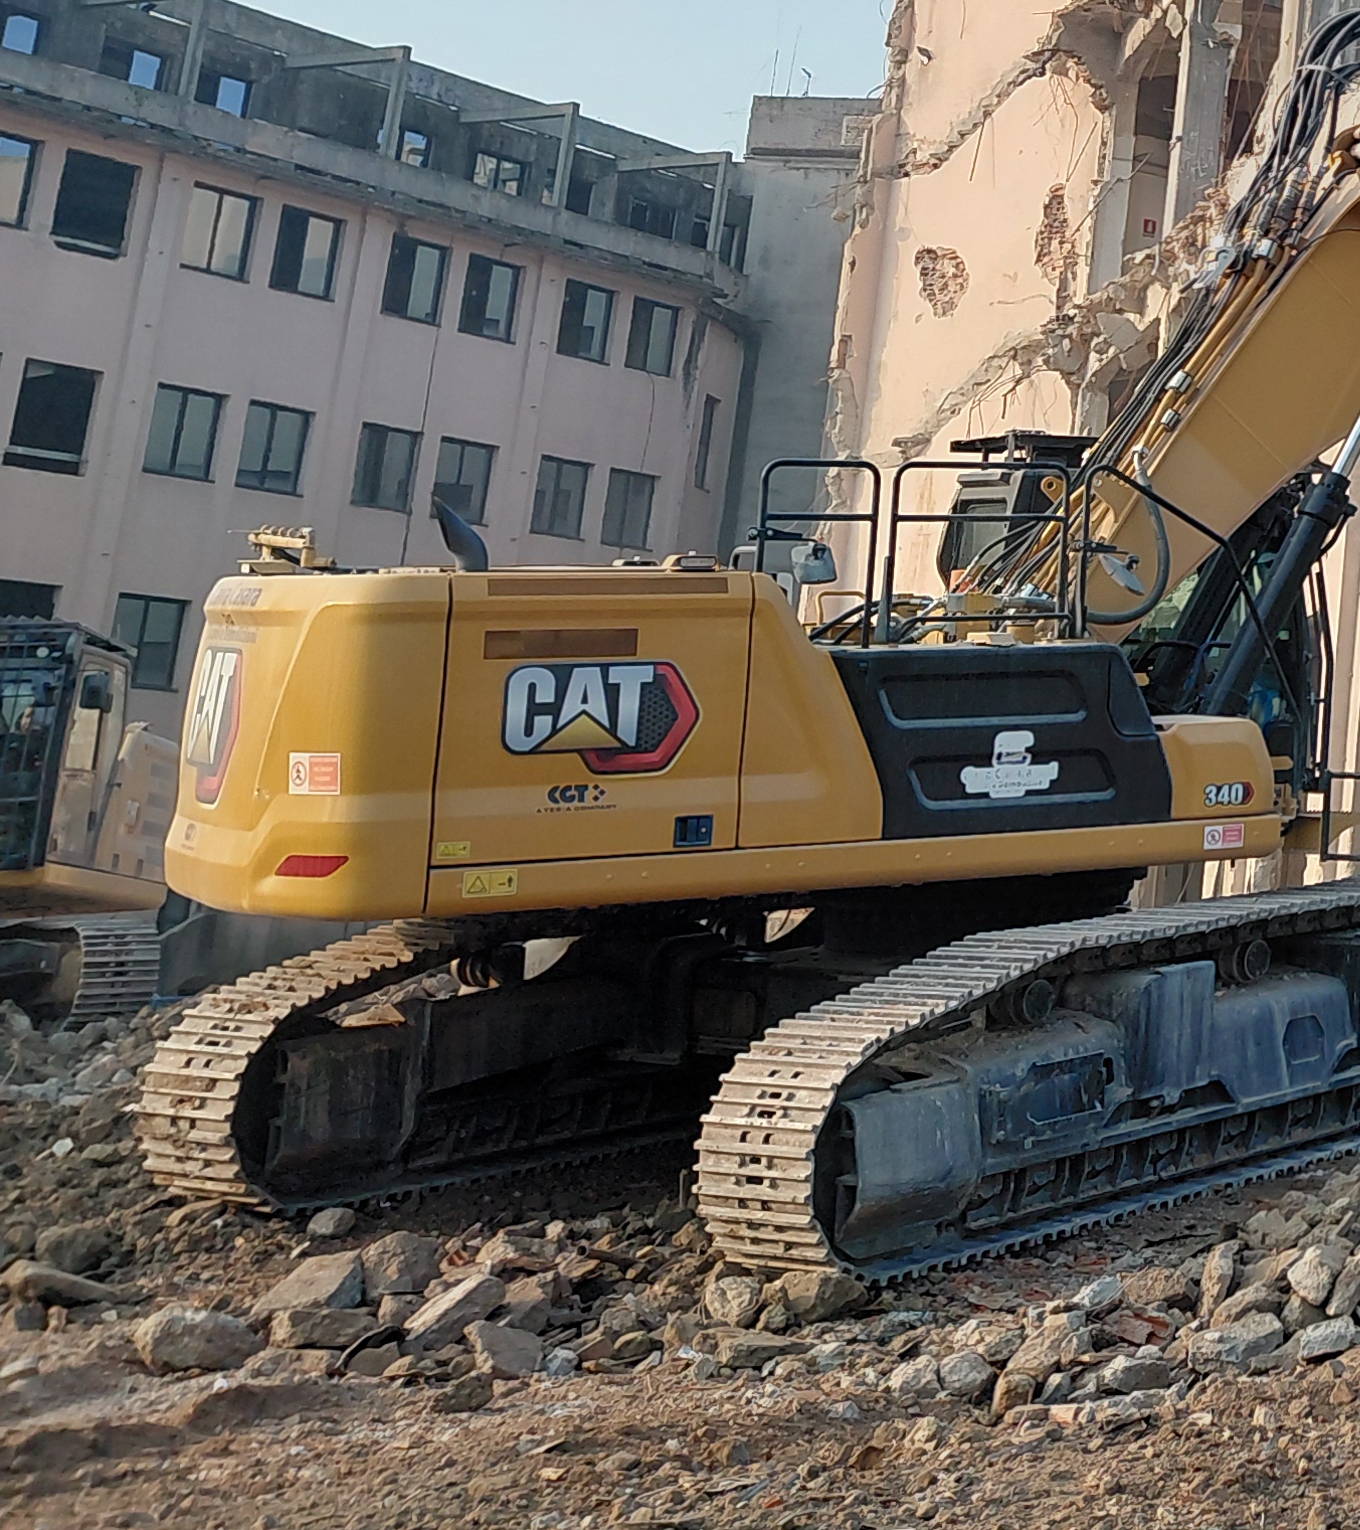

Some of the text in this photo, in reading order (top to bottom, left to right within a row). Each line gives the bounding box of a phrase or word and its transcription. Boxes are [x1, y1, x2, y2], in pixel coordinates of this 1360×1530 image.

[187, 648, 239, 765] CAT
[504, 664, 655, 753] CAT
[548, 785, 589, 804] CGT
[1204, 783, 1244, 807] 340
